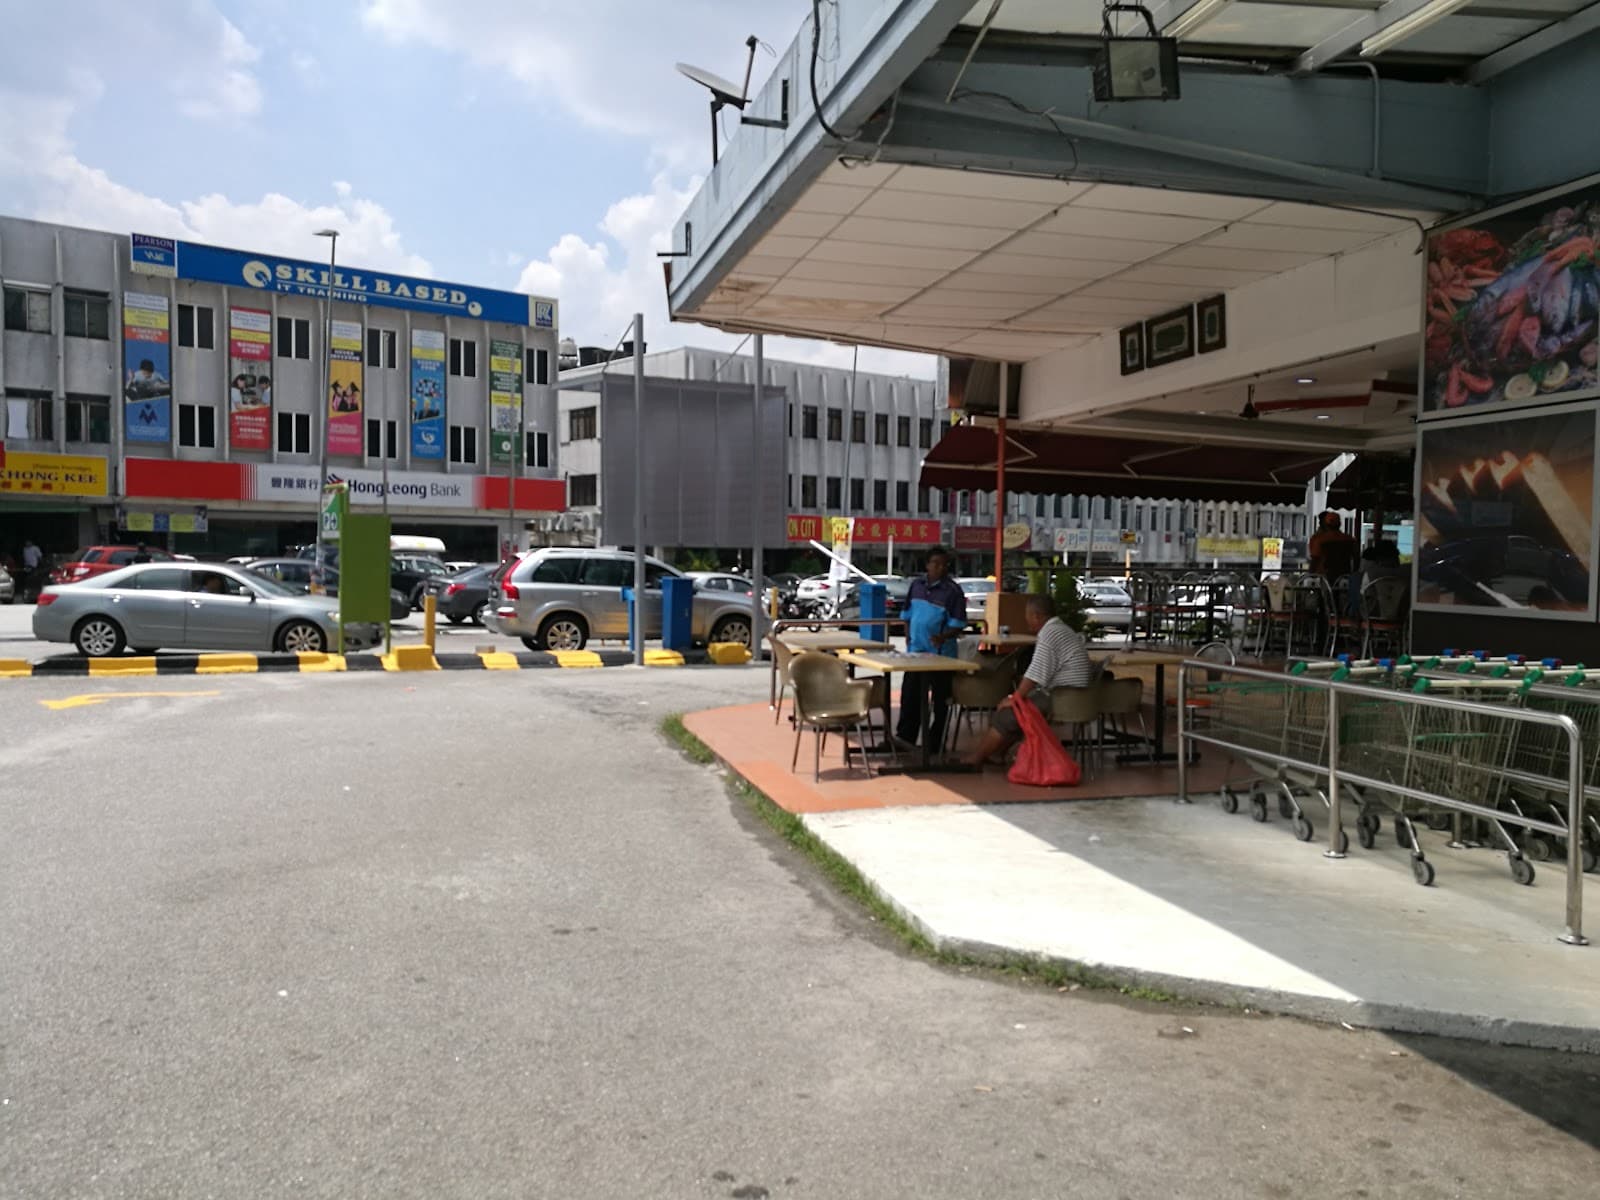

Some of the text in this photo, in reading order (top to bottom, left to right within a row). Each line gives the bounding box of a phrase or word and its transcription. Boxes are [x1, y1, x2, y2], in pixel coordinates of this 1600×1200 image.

[135, 235, 173, 248] PEARSON
[275, 264, 467, 305] SKILL BASED
[277, 284, 367, 302] IT TRAINING
[65, 473, 97, 483] KEE
[430, 484, 462, 497] Bank
